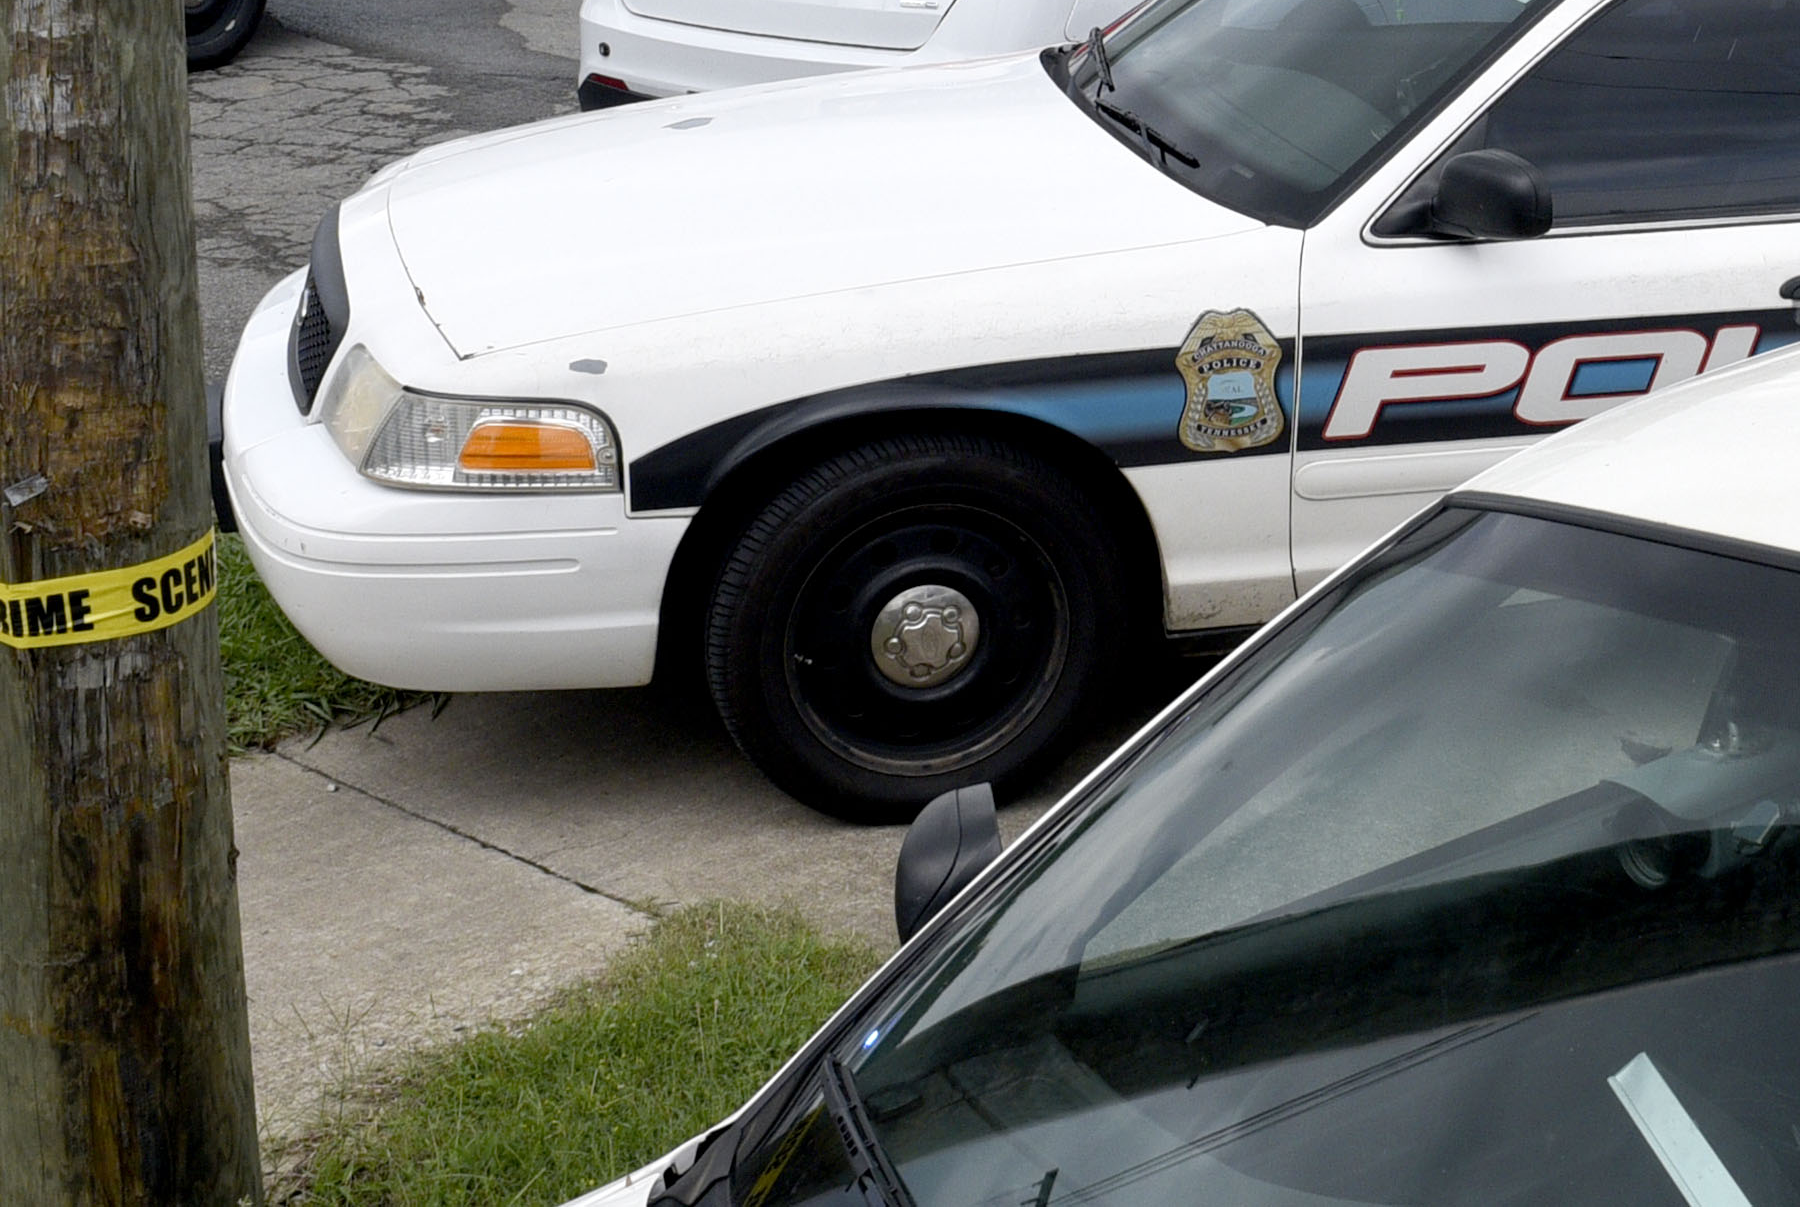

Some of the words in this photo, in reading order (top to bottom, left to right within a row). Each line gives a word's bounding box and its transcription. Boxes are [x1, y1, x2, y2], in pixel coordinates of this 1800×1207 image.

[1193, 340, 1267, 362] CHATTANOOGA
[1203, 359, 1258, 373] POLICE
[1201, 420, 1263, 437] TENNESSEE
